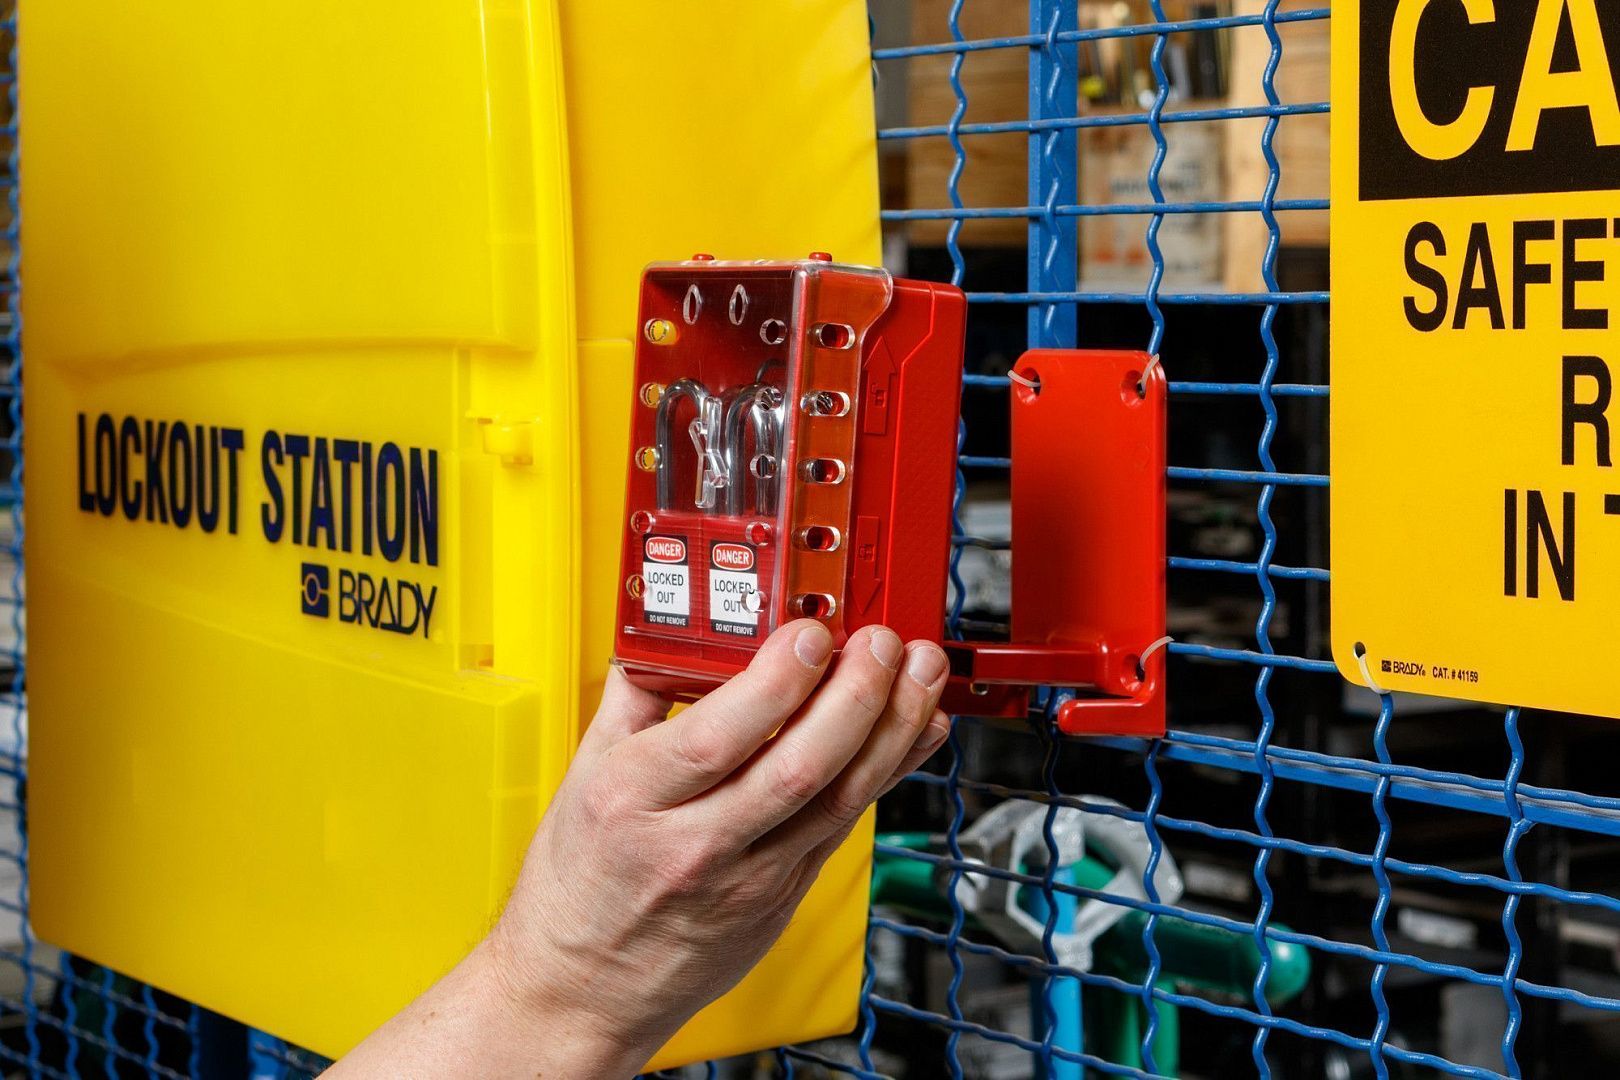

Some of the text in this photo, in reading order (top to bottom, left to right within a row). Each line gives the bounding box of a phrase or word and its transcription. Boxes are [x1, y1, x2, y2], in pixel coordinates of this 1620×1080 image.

[1403, 218, 1620, 332] SAFE
[78, 413, 438, 566] LOCKOUT STATION
[649, 542, 682, 557] DANGER
[1504, 489, 1575, 601] IN
[715, 550, 750, 565] DANGER
[648, 572, 684, 586] LOCKED
[714, 579, 753, 594] LOCKED
[339, 569, 437, 639] BRADY
[657, 591, 676, 604] OUT
[649, 614, 686, 626] DO NOT REMOVE
[715, 623, 753, 635] DO NOT REMOVE
[1432, 666, 1449, 680] CAT.
